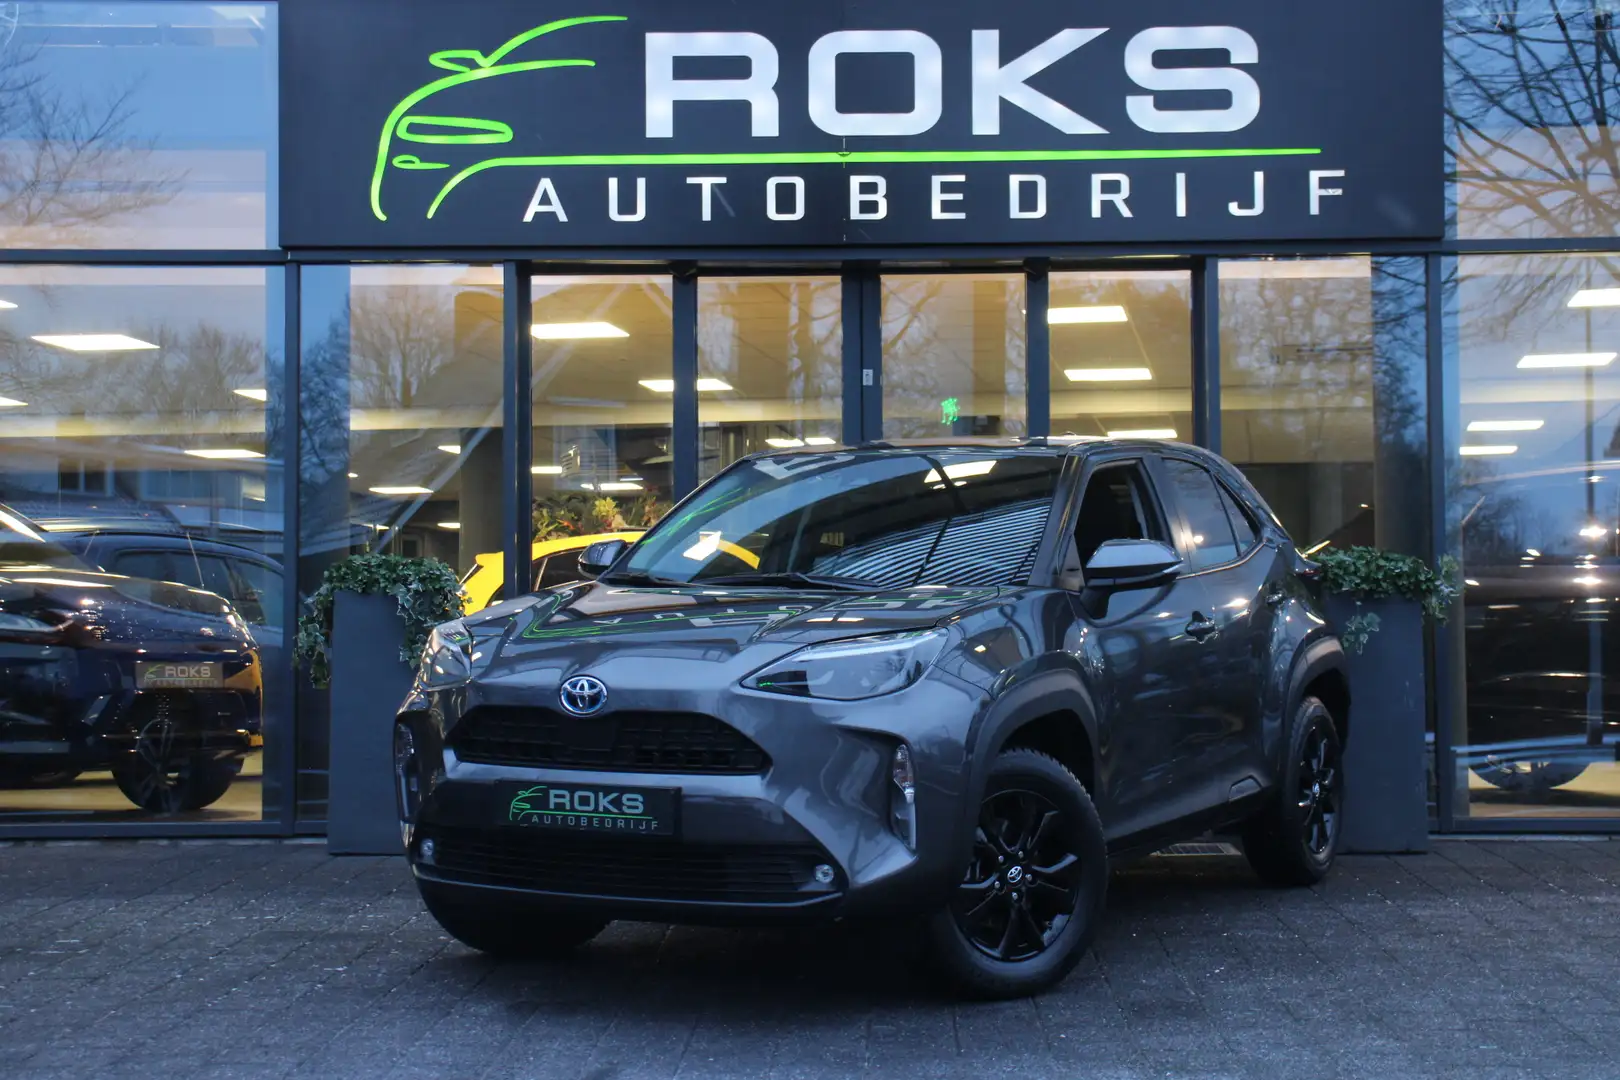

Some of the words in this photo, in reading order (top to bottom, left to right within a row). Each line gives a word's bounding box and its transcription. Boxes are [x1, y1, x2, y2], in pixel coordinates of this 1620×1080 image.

[645, 26, 1261, 138] ROKS
[522, 169, 1346, 223] AUTOBEDRIJF
[165, 666, 211, 678] ROKS
[548, 789, 644, 814] ROKS
[531, 814, 659, 831] AUTOBEDRIJF
